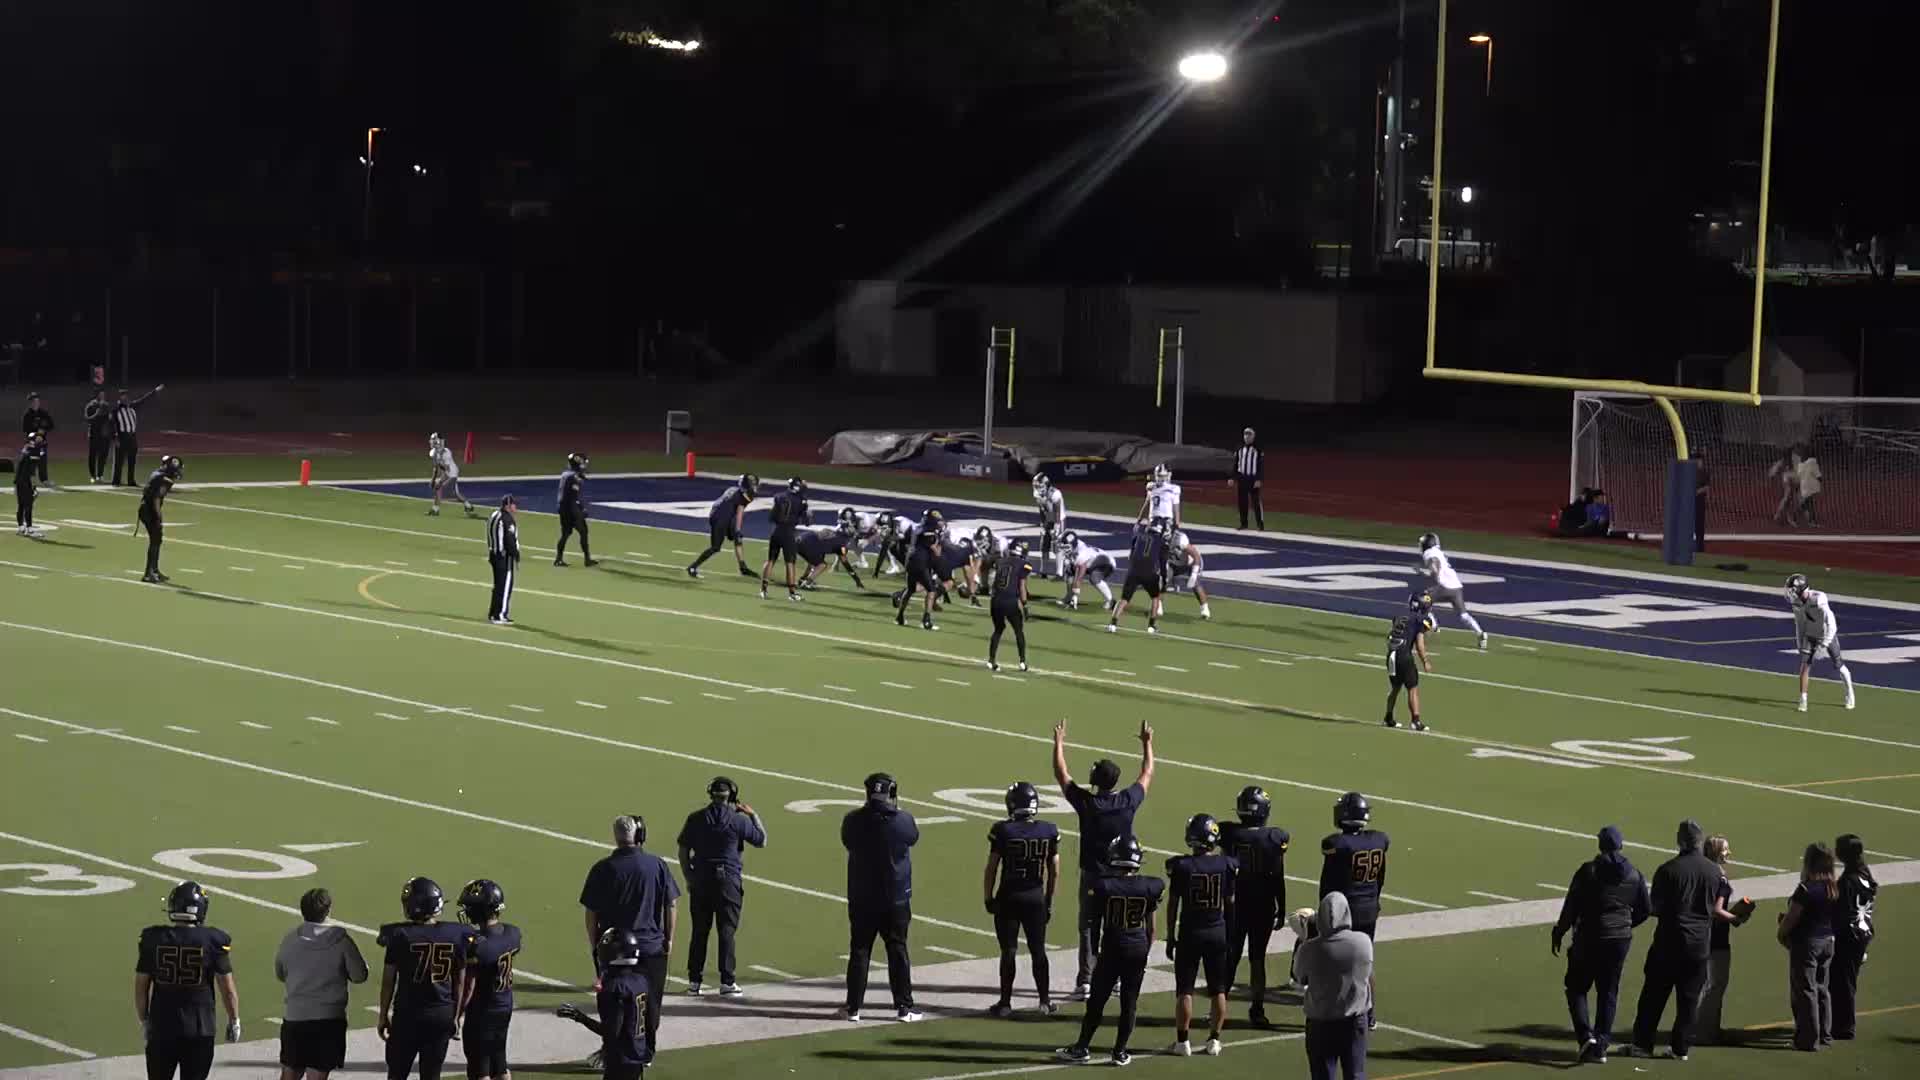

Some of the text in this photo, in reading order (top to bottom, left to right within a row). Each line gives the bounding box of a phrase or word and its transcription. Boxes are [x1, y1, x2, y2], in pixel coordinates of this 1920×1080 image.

[1466, 740, 1695, 769] 10
[0, 847, 318, 897] 30
[1006, 837, 1049, 880] 24
[1189, 872, 1222, 909] 21
[155, 944, 204, 986] 55
[409, 941, 455, 985] 75
